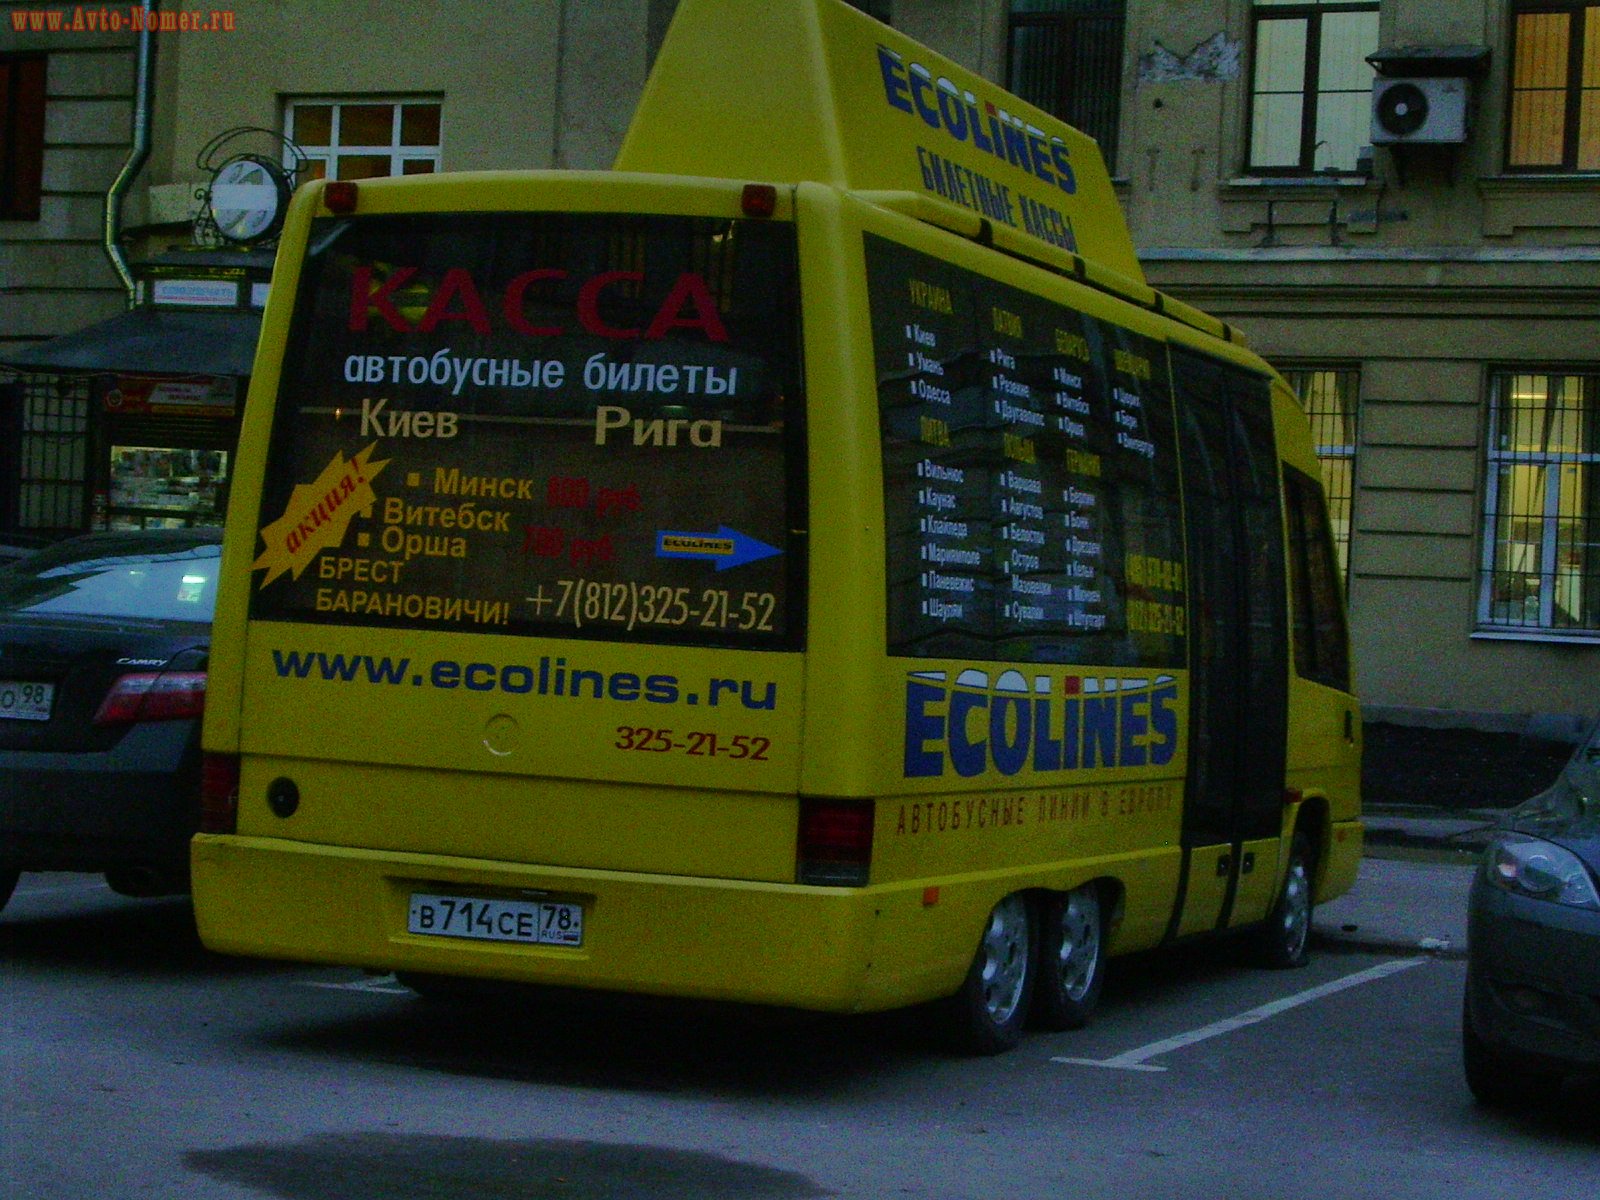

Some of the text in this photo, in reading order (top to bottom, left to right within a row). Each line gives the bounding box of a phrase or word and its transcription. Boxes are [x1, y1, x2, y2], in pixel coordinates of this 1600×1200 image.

[916, 145, 1018, 228] БИЛЕТНЫЕ
[346, 266, 730, 343] КАССА
[908, 278, 955, 315] УКРАИНА
[913, 322, 937, 348] Киев
[343, 347, 738, 396] автобусные билеты
[918, 378, 951, 405] Одесса
[360, 398, 459, 439] Киев
[594, 404, 722, 448] Рига
[433, 466, 533, 500] Минск
[924, 458, 964, 484] Вильнюс
[286, 457, 366, 554] акция!
[384, 497, 512, 533] Витебск
[926, 486, 956, 512] Каунас
[381, 525, 468, 560] Орша
[319, 556, 404, 584] БРЕСТ
[315, 588, 512, 626] БАРАНОВИЧИ!
[526, 578, 776, 631] +7(812)325-21-52
[272, 649, 778, 711] www.ecolines.ru
[614, 726, 772, 761] 325-21-52
[897, 796, 1025, 835] АВТОБУСНЫЕ
[1038, 789, 1090, 824] ЛИНИИ
